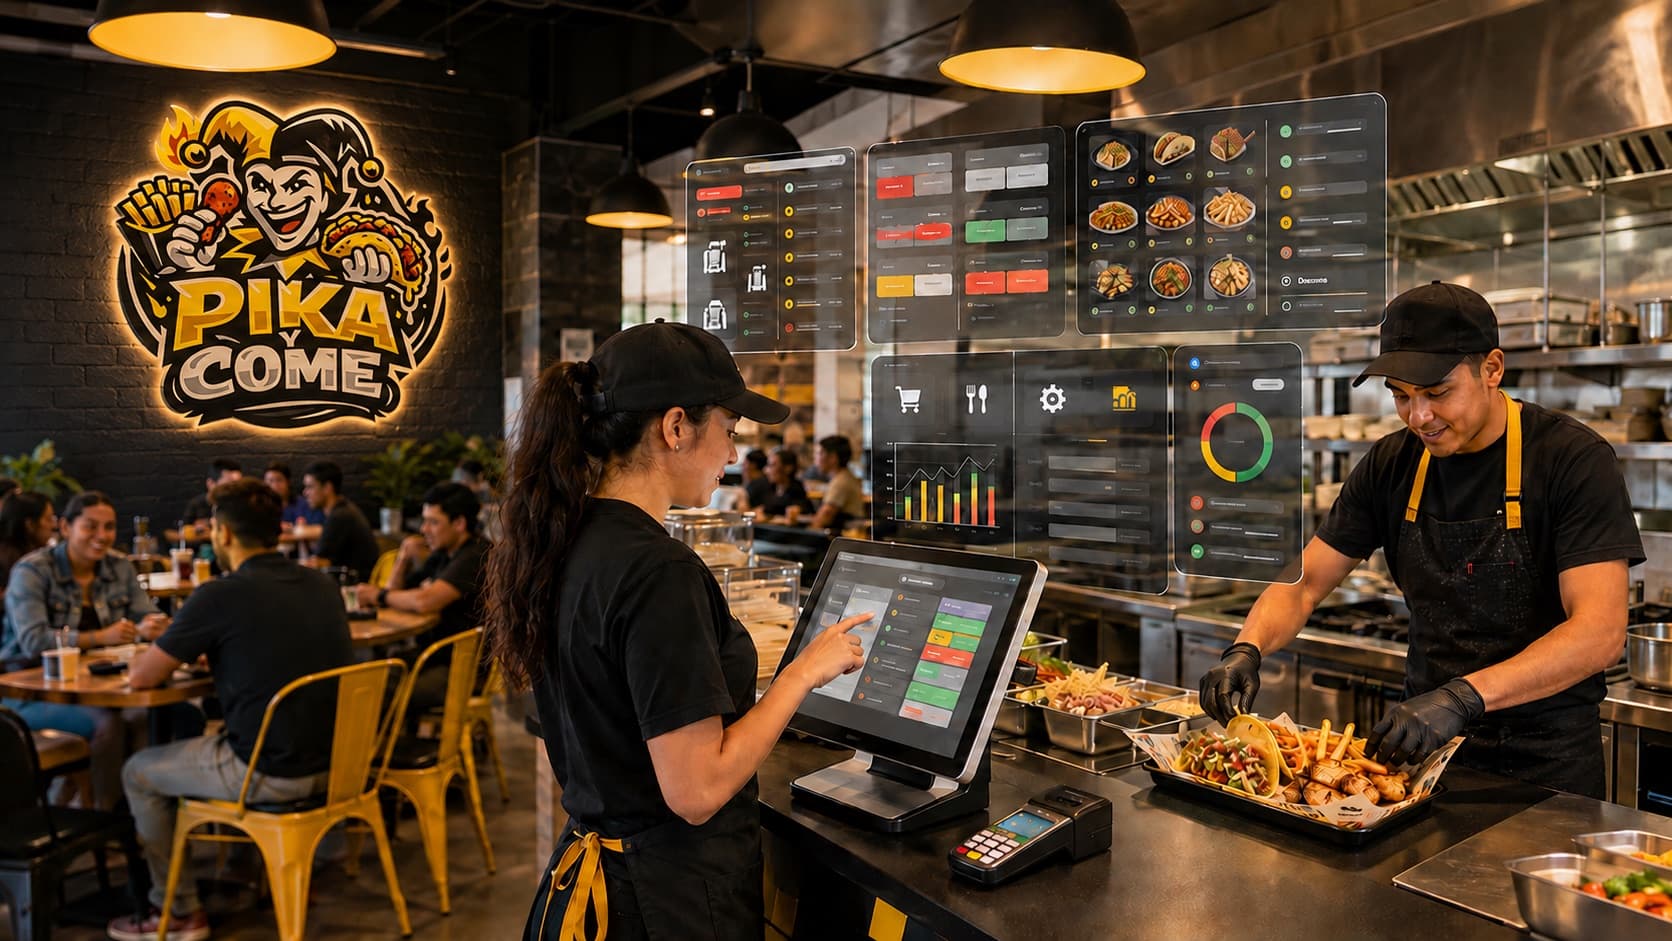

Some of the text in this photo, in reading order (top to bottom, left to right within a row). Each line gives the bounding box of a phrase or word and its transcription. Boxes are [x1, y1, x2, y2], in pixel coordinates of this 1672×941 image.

[170, 277, 399, 353] PIKA
[278, 329, 301, 348] Y
[180, 345, 383, 400] COME
